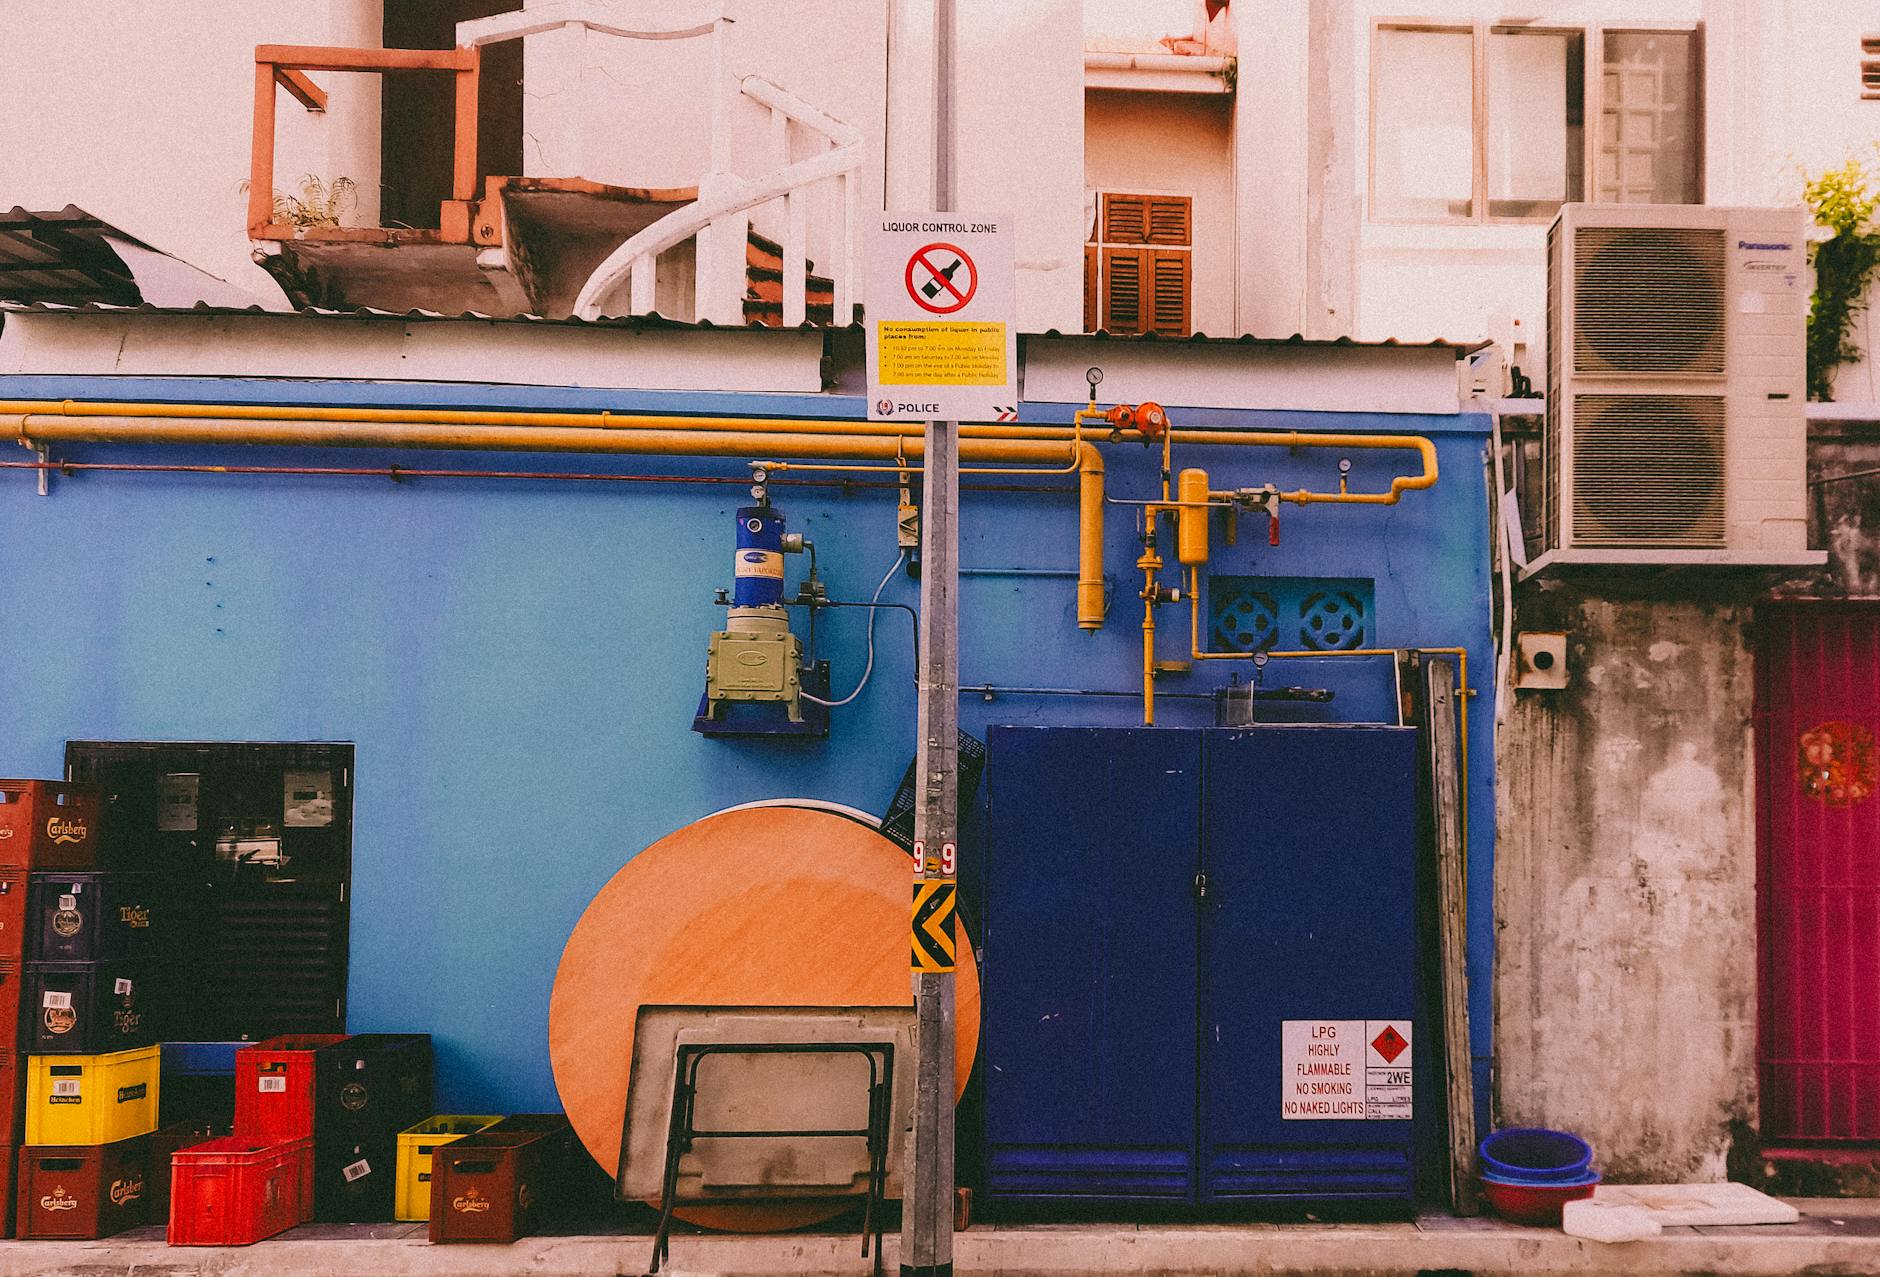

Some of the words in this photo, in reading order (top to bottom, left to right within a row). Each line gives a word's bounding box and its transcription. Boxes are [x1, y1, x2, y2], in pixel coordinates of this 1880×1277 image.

[882, 222, 920, 233] LIQUOR
[922, 222, 969, 233] CONTROL
[970, 223, 997, 233] ZONE
[1738, 240, 1792, 251] Panasonic
[898, 403, 940, 413] POLICE
[47, 817, 87, 841] Carlsberg
[913, 841, 924, 873] 9
[942, 843, 956, 875] 9
[120, 905, 149, 928] Tiger
[113, 1010, 141, 1033] Tiger
[1311, 1026, 1337, 1039] LPG
[1308, 1044, 1340, 1056] HIGHLY
[1297, 1063, 1351, 1076] FLAMMABLE
[1386, 1071, 1411, 1084] 2WE
[1296, 1082, 1309, 1095] NO
[1311, 1082, 1353, 1095] SMOKING
[1284, 1101, 1298, 1115] NO
[1300, 1101, 1330, 1115] NAKED
[1332, 1101, 1364, 1115] LIGHTS
[110, 1178, 143, 1203] Carlsber
[40, 1195, 78, 1211] Carlsberg
[453, 1197, 490, 1211] Carlsberg
